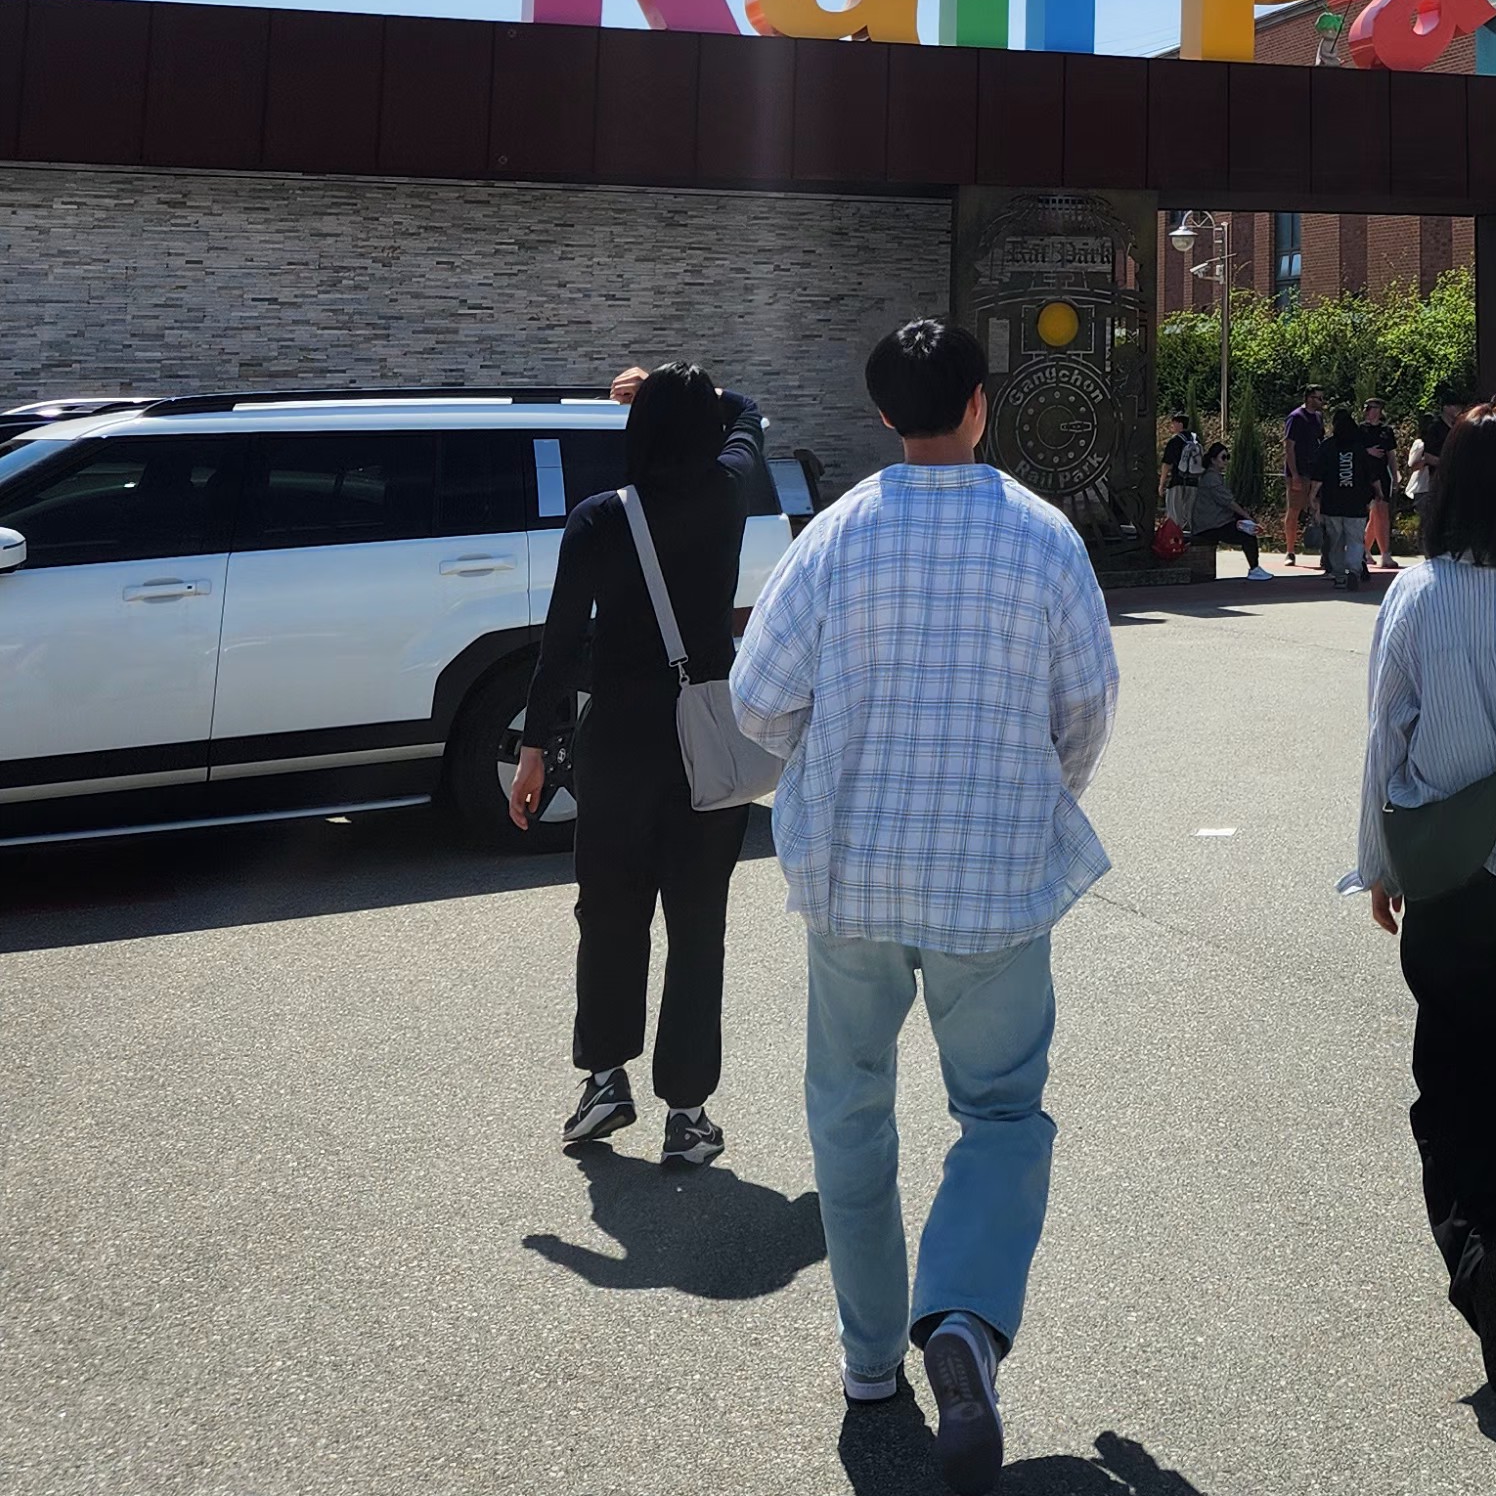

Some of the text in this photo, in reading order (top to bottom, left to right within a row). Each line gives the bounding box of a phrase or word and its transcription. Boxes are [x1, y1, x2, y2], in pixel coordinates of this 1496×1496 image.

[1008, 367, 1104, 406] Gangchon
[1015, 453, 1104, 488] Rail Park
